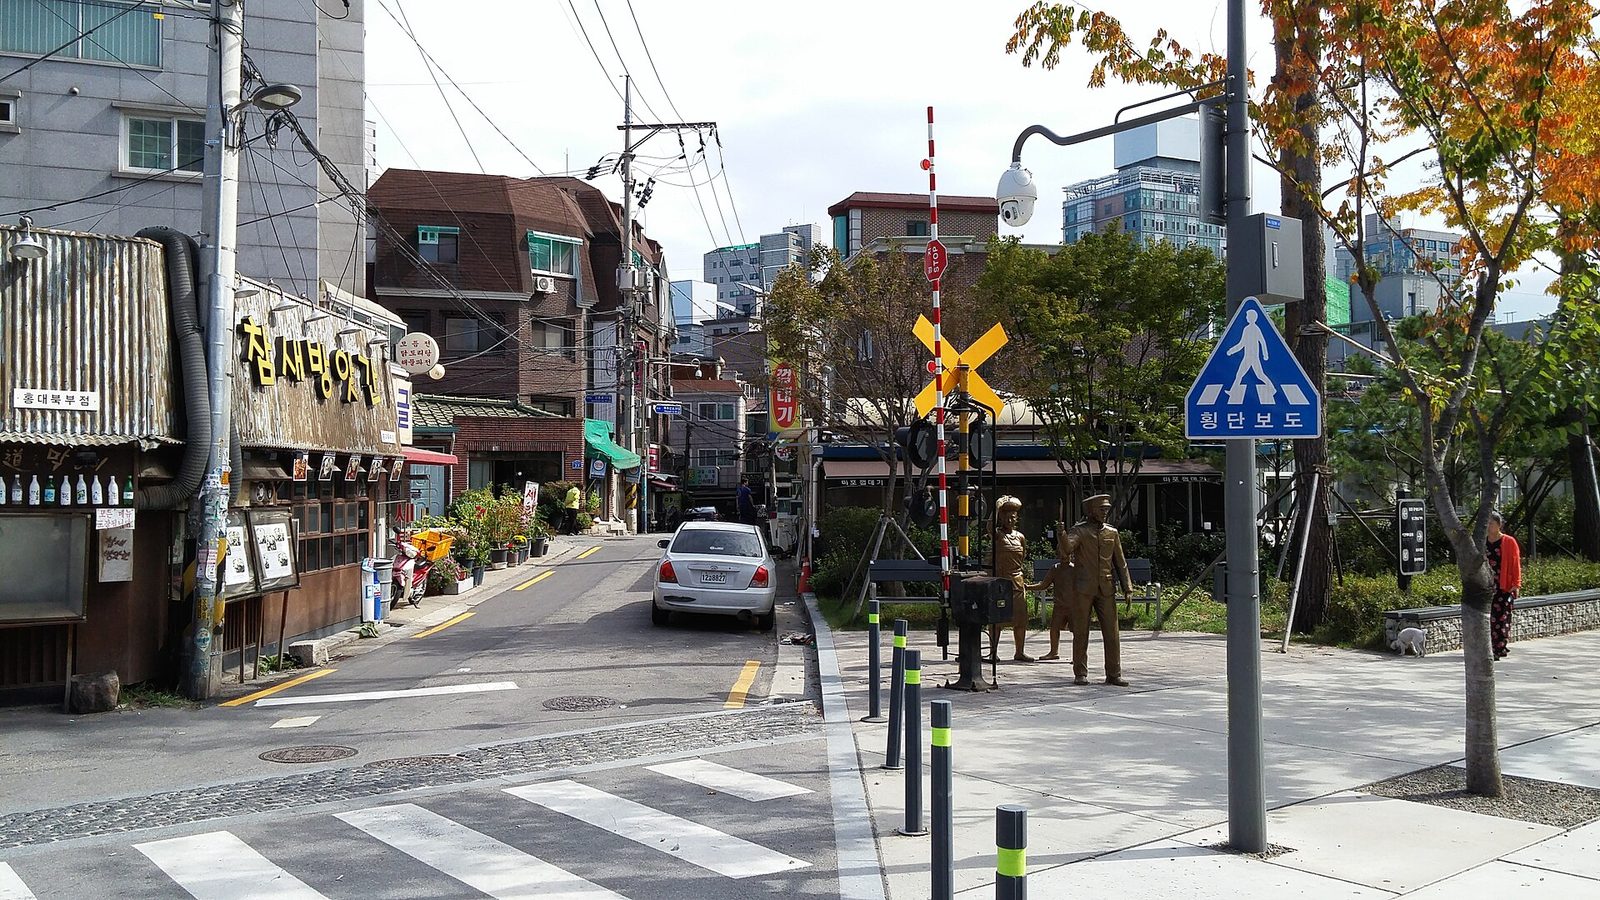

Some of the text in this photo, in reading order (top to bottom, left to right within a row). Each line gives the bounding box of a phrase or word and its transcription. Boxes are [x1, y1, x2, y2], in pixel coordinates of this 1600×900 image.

[243, 315, 381, 406] 참새방앗간
[23, 392, 90, 407] 홍대북부점
[1200, 411, 1303, 430] 횡단보도
